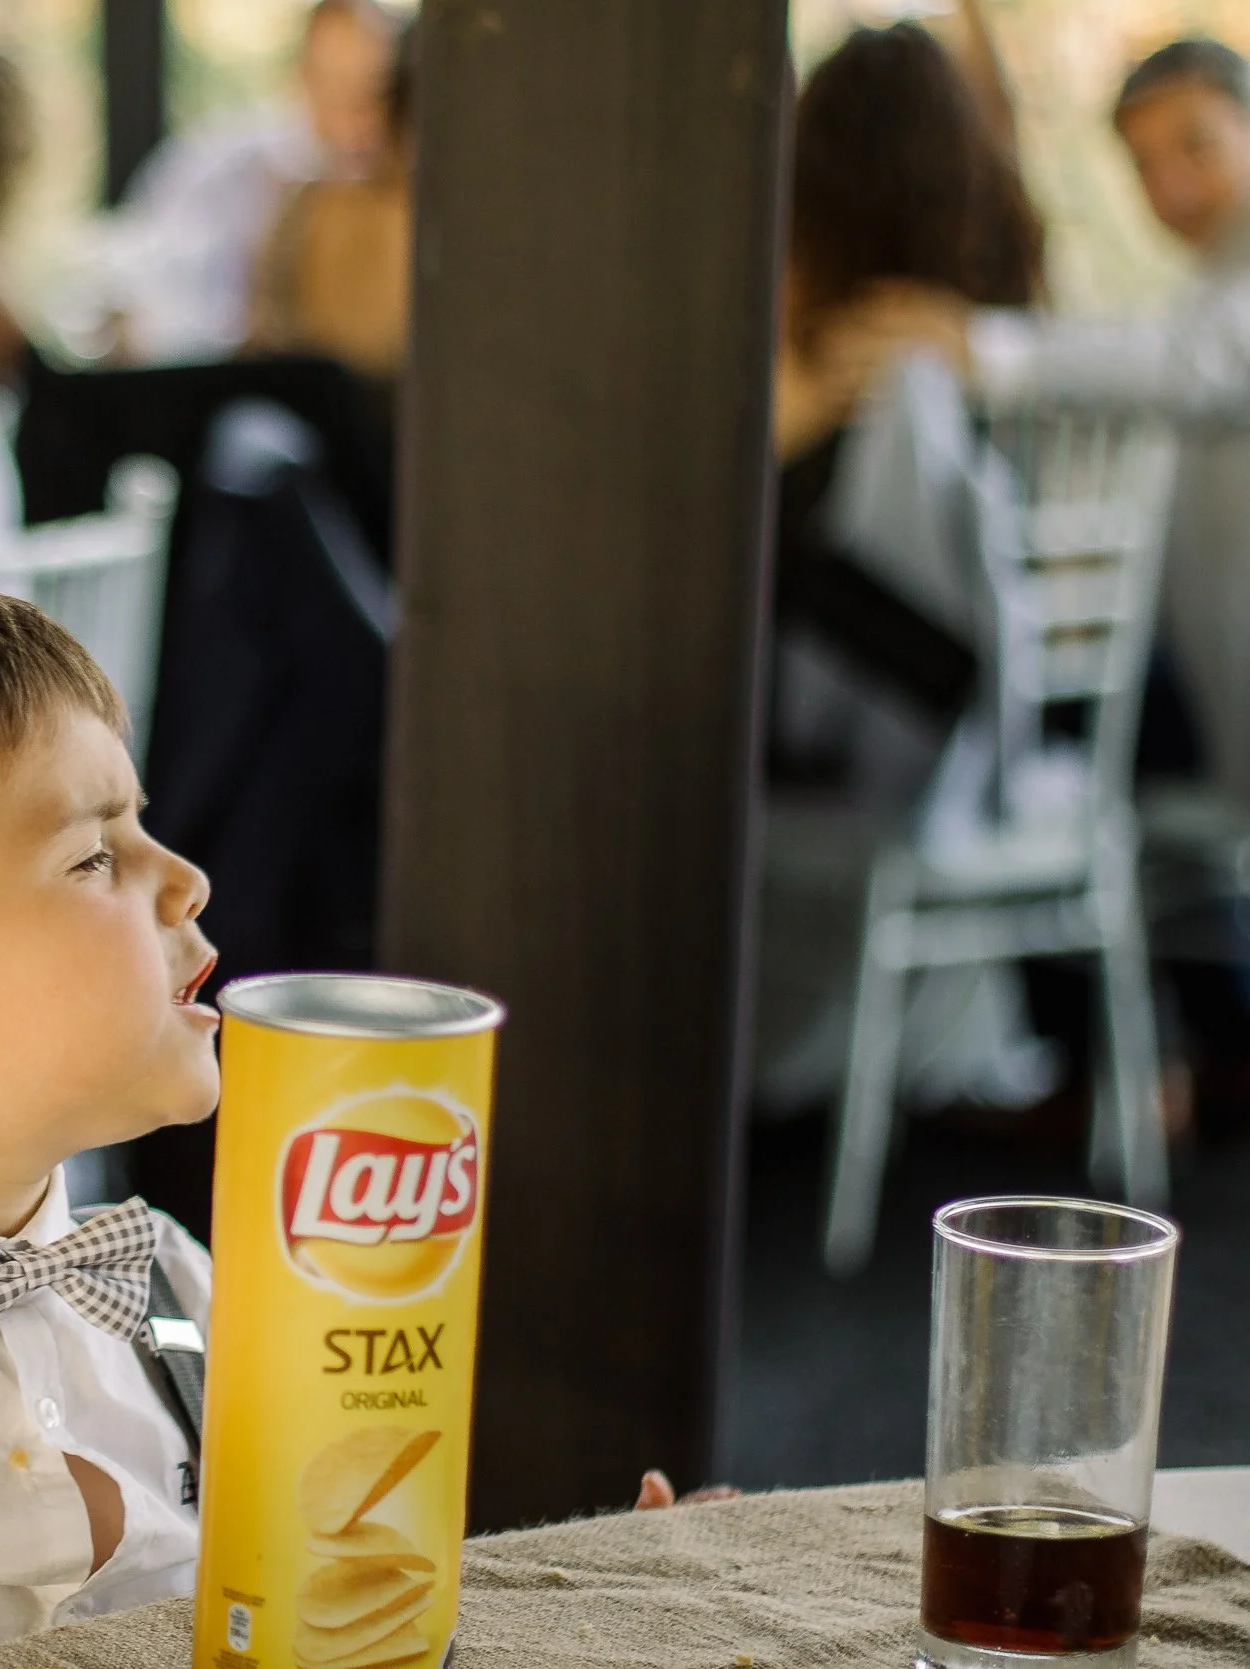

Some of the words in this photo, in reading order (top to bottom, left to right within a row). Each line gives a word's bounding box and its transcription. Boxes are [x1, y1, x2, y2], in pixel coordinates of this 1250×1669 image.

[291, 1133, 476, 1244] Lay's
[322, 1323, 446, 1376] STAX
[340, 1388, 429, 1411] ORIGINAL
